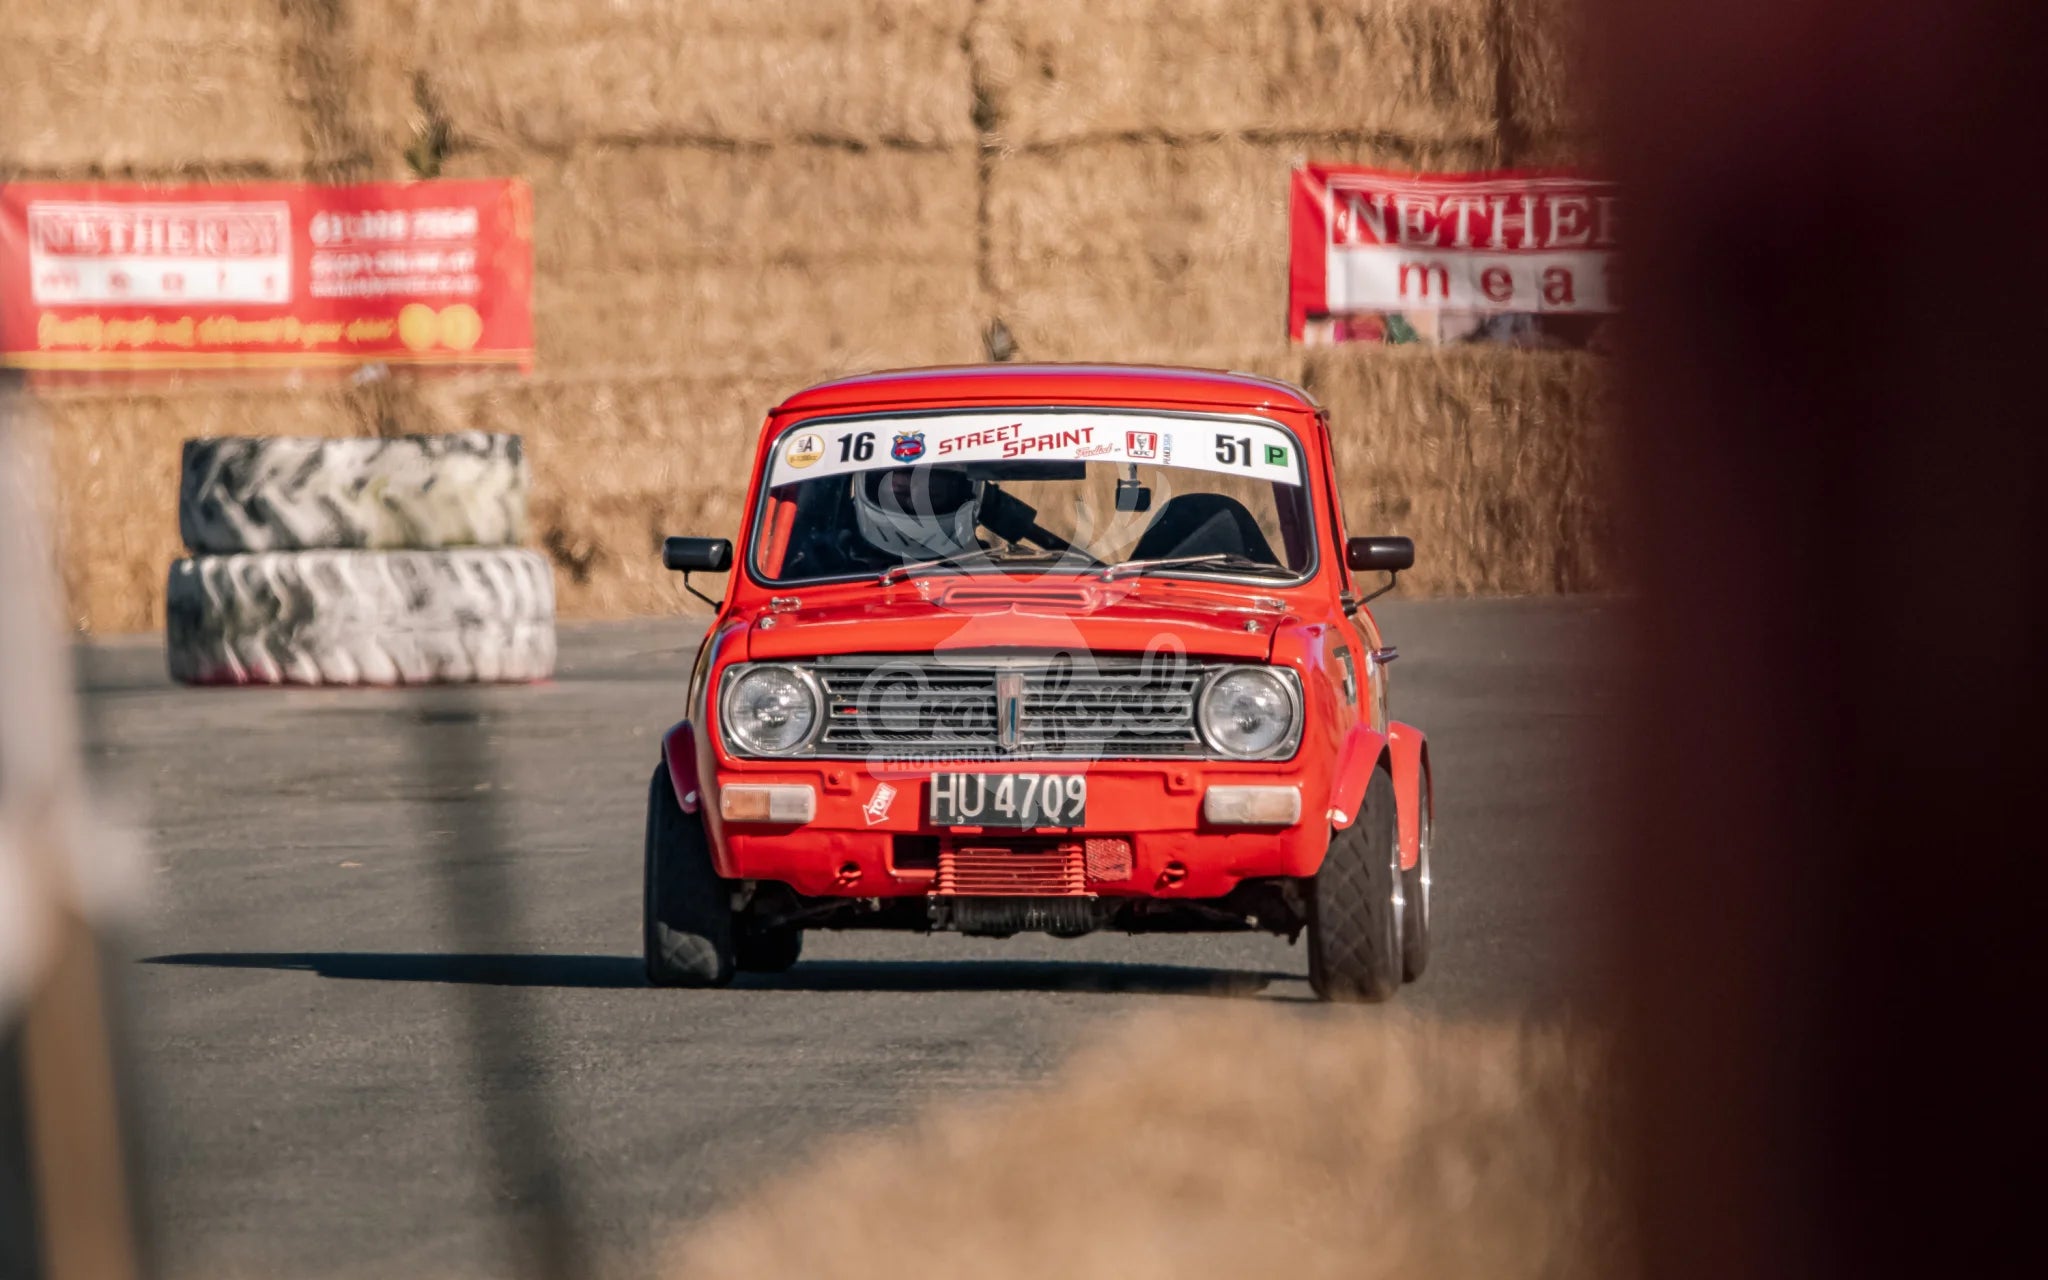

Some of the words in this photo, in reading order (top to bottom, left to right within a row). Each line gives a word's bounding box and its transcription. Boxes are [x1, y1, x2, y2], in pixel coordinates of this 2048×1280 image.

[837, 432, 876, 463] 16
[938, 423, 1022, 455] STREET
[1002, 427, 1094, 458] SPRINT
[1215, 433, 1253, 468] 51
[1268, 447, 1284, 464] P
[868, 787, 892, 816] TOW
[930, 772, 986, 818] HU
[994, 773, 1087, 819] 4709
